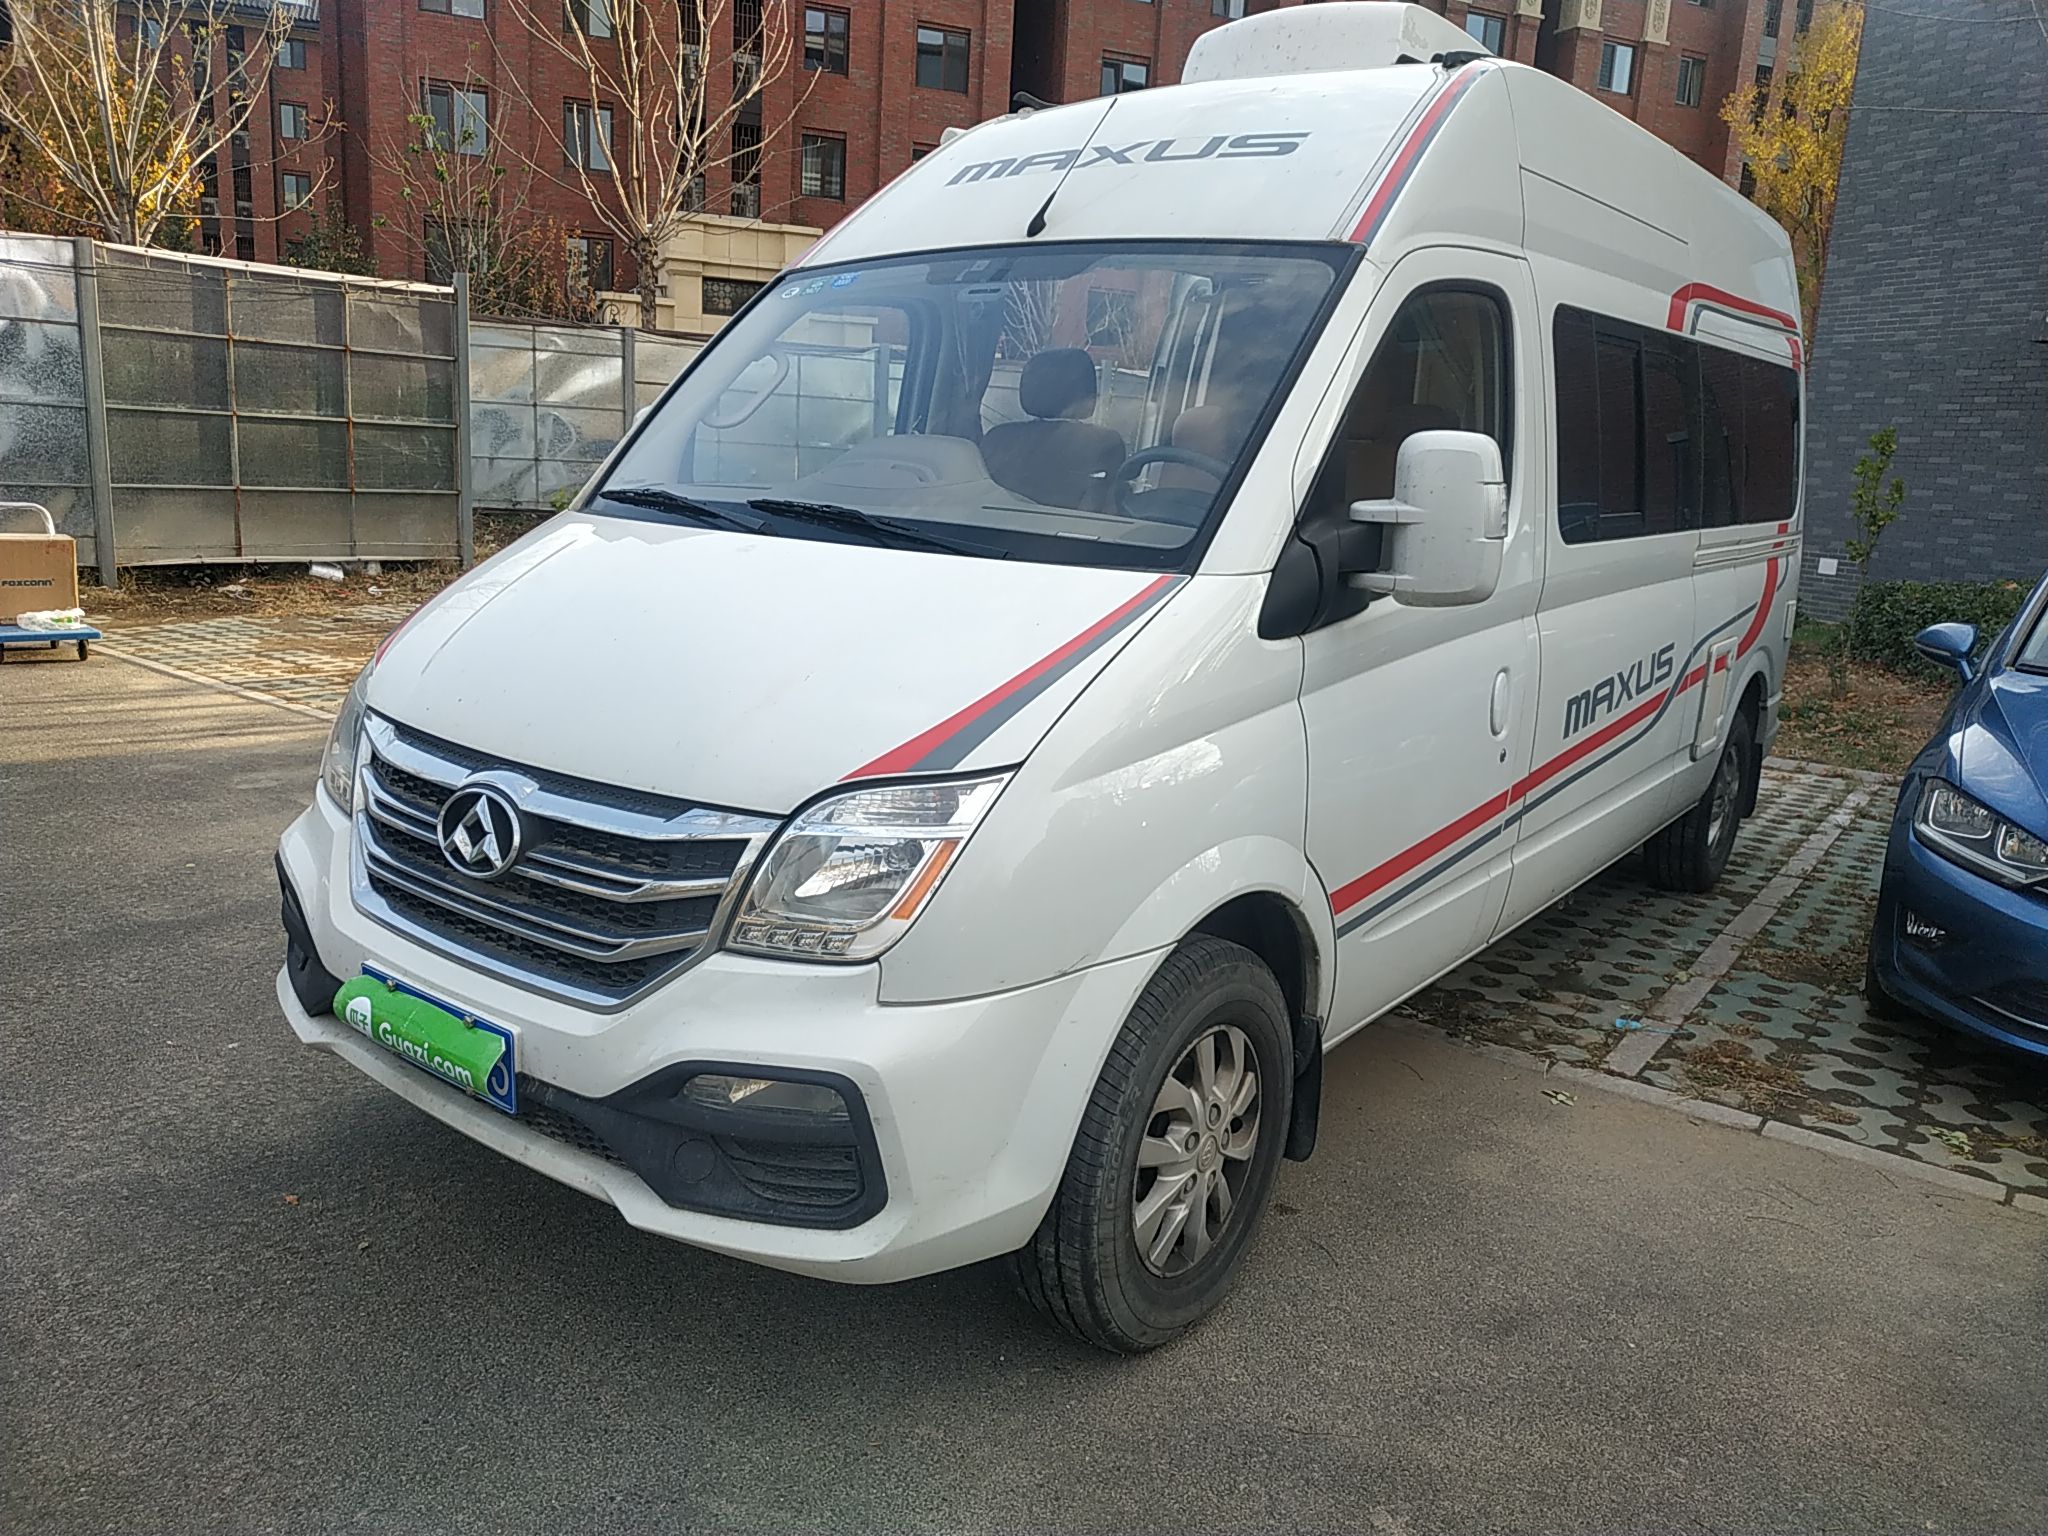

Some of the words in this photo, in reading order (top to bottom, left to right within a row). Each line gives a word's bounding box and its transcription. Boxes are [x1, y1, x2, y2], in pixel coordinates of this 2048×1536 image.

[945, 132, 1311, 187] MAXUS
[1563, 642, 1675, 740] MAXUS
[350, 1007, 368, 1031] 瓜子
[378, 1021, 474, 1088] Guazi.com
